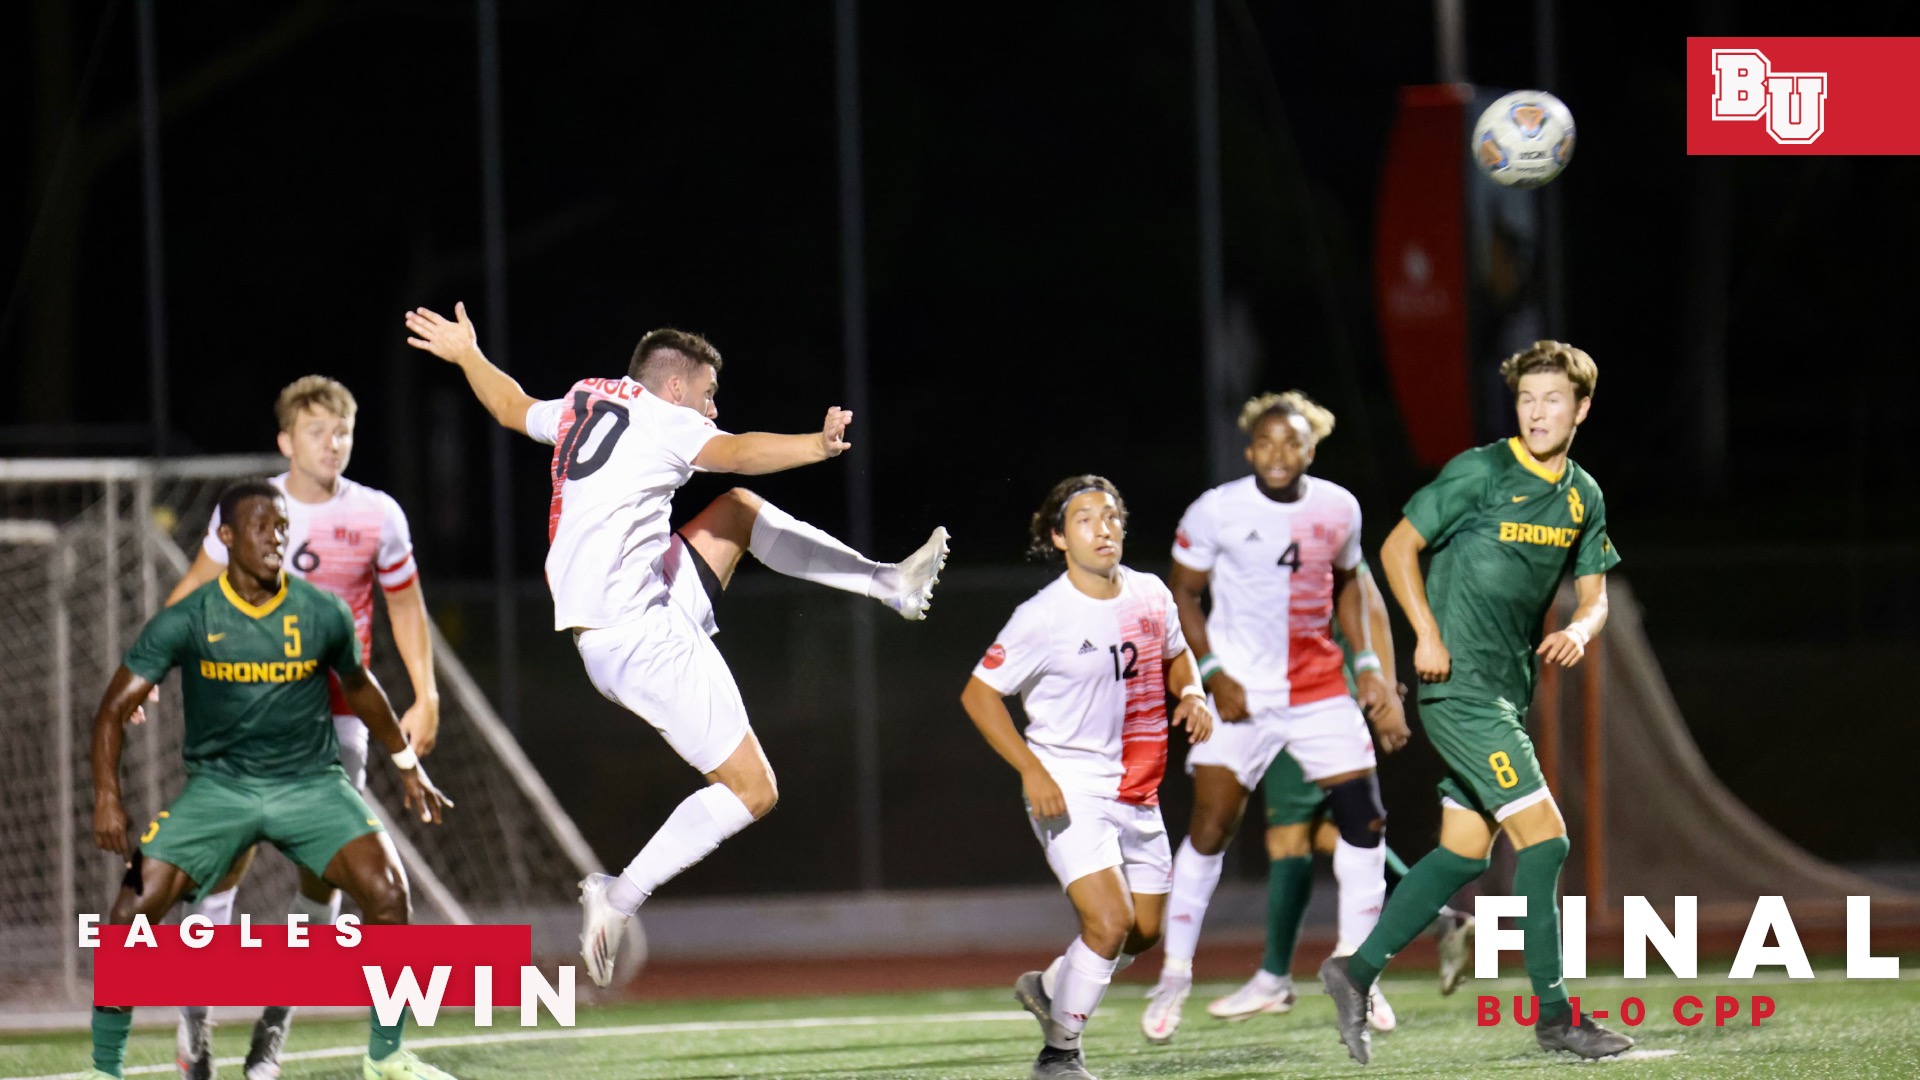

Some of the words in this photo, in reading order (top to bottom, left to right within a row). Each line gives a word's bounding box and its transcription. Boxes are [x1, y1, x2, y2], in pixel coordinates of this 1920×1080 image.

[556, 390, 630, 481] 10
[1499, 521, 1581, 548] BRONC
[292, 540, 320, 573] 6
[1277, 541, 1301, 573] 4
[283, 615, 302, 658] 5
[200, 659, 318, 683] BRONCOS
[1109, 641, 1139, 682] 12
[1488, 750, 1519, 789] 8
